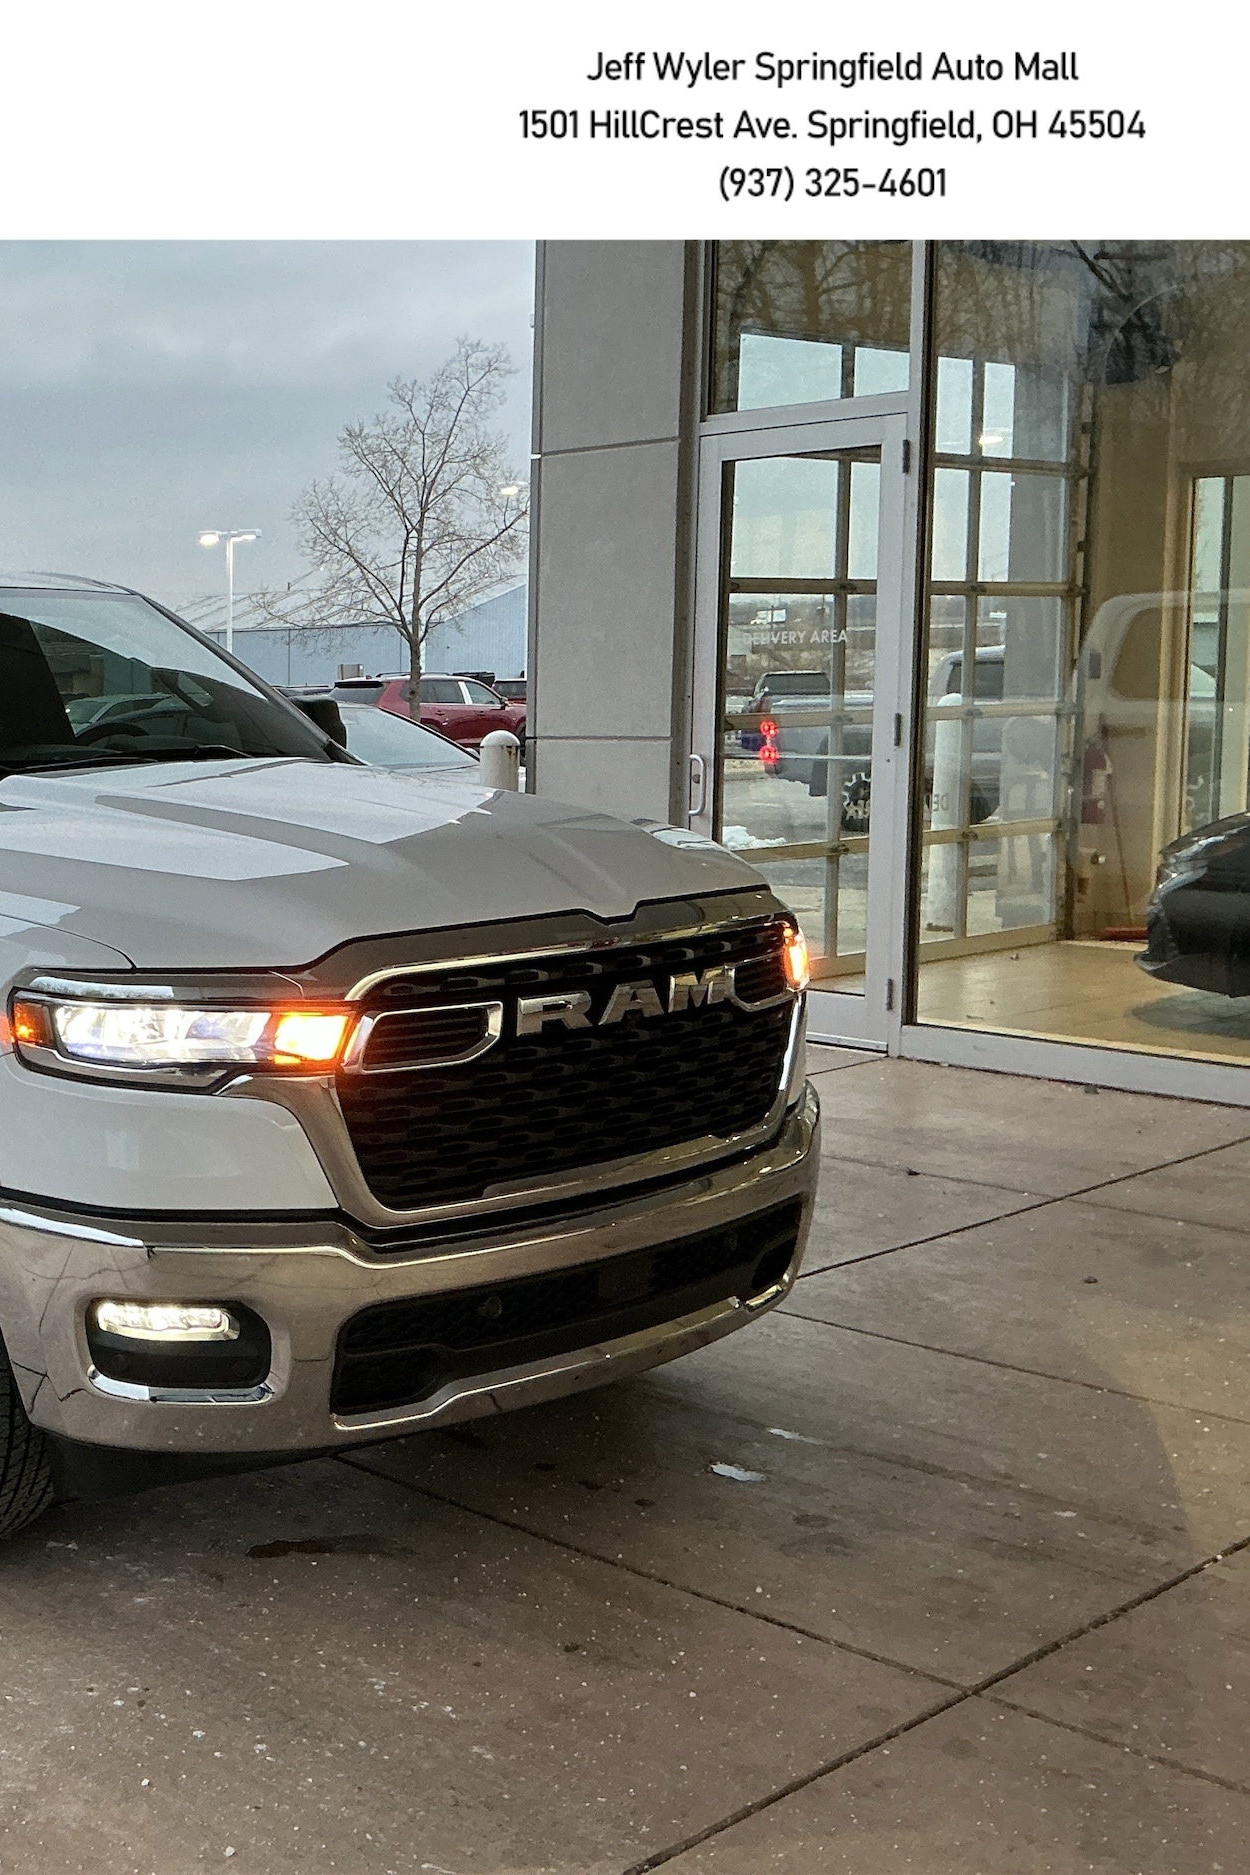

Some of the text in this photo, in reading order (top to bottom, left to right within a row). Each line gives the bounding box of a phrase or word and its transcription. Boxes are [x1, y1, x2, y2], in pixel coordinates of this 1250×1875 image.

[743, 629, 849, 646] DELIVERY AREA
[516, 964, 735, 1038] RAM
